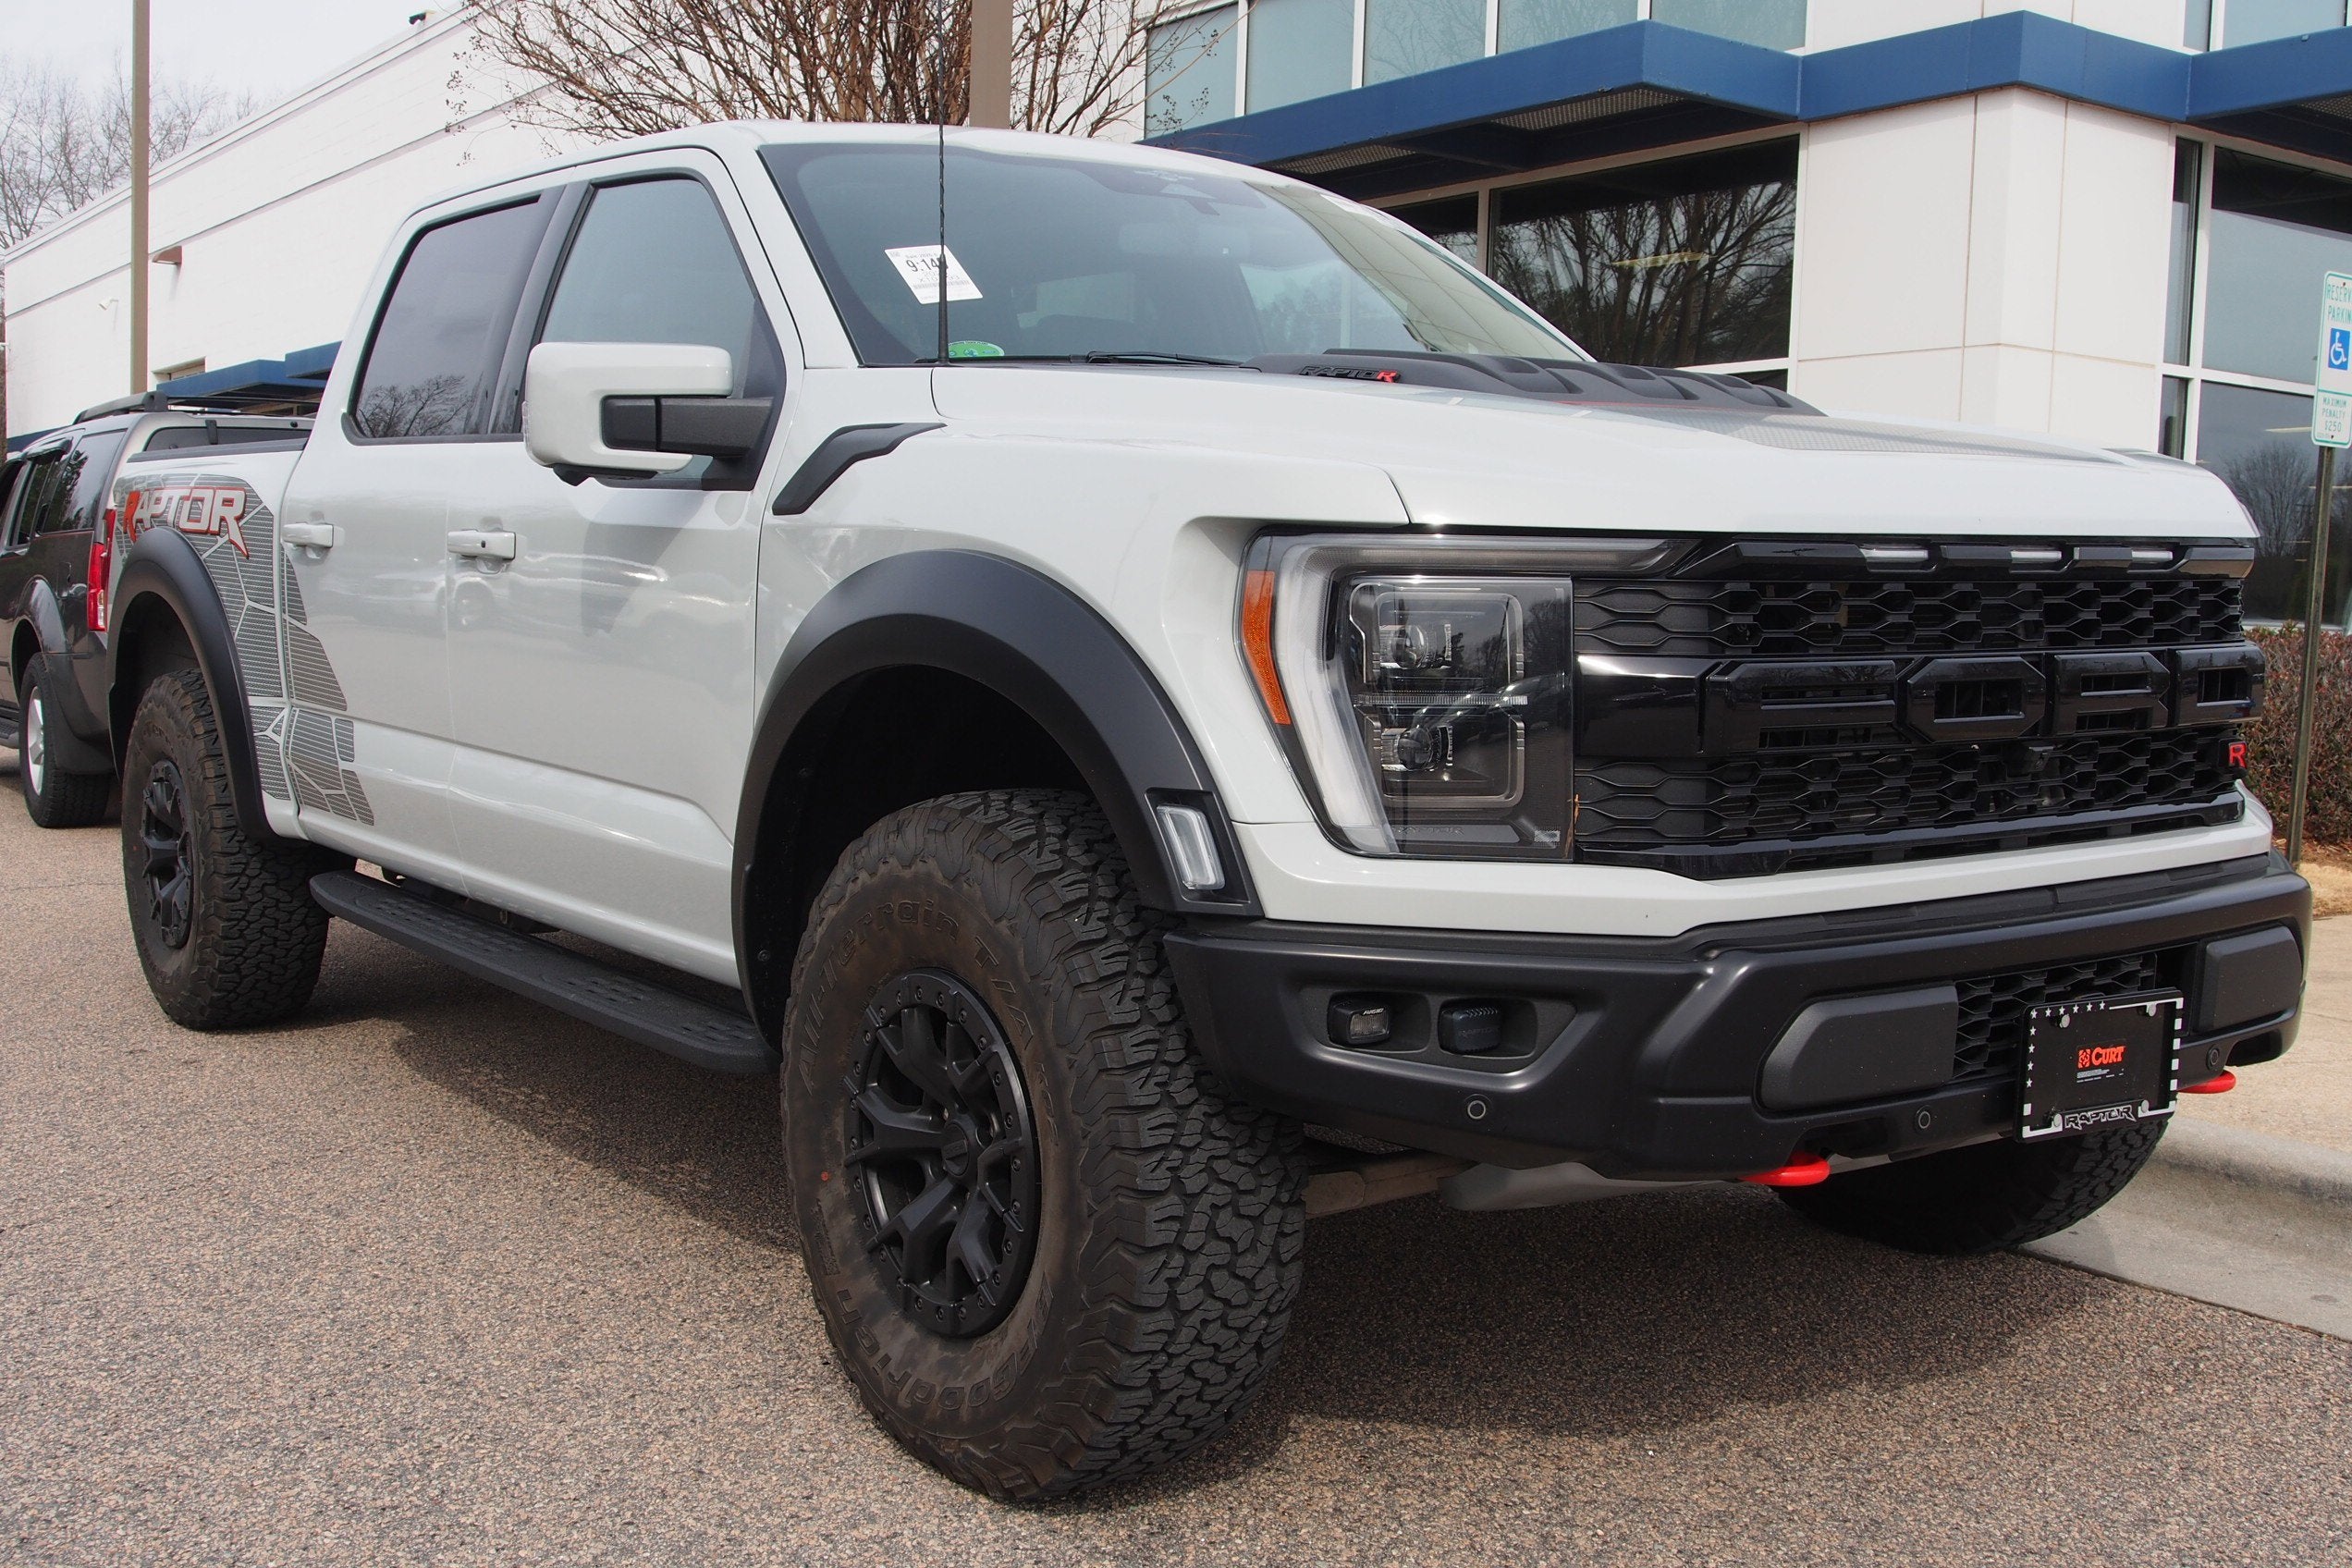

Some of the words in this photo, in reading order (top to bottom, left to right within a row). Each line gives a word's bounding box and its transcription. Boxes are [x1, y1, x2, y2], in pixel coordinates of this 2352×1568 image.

[906, 257, 949, 272] 9:14
[1299, 365, 1402, 384] RAPTOR
[2322, 398, 2347, 409] MAXIMUM
[2321, 408, 2346, 420] PENALTY
[2324, 420, 2342, 433] $250
[2229, 742, 2247, 768] R
[2091, 1046, 2125, 1066] CURT
[2064, 1105, 2138, 1131] RAPTOR
